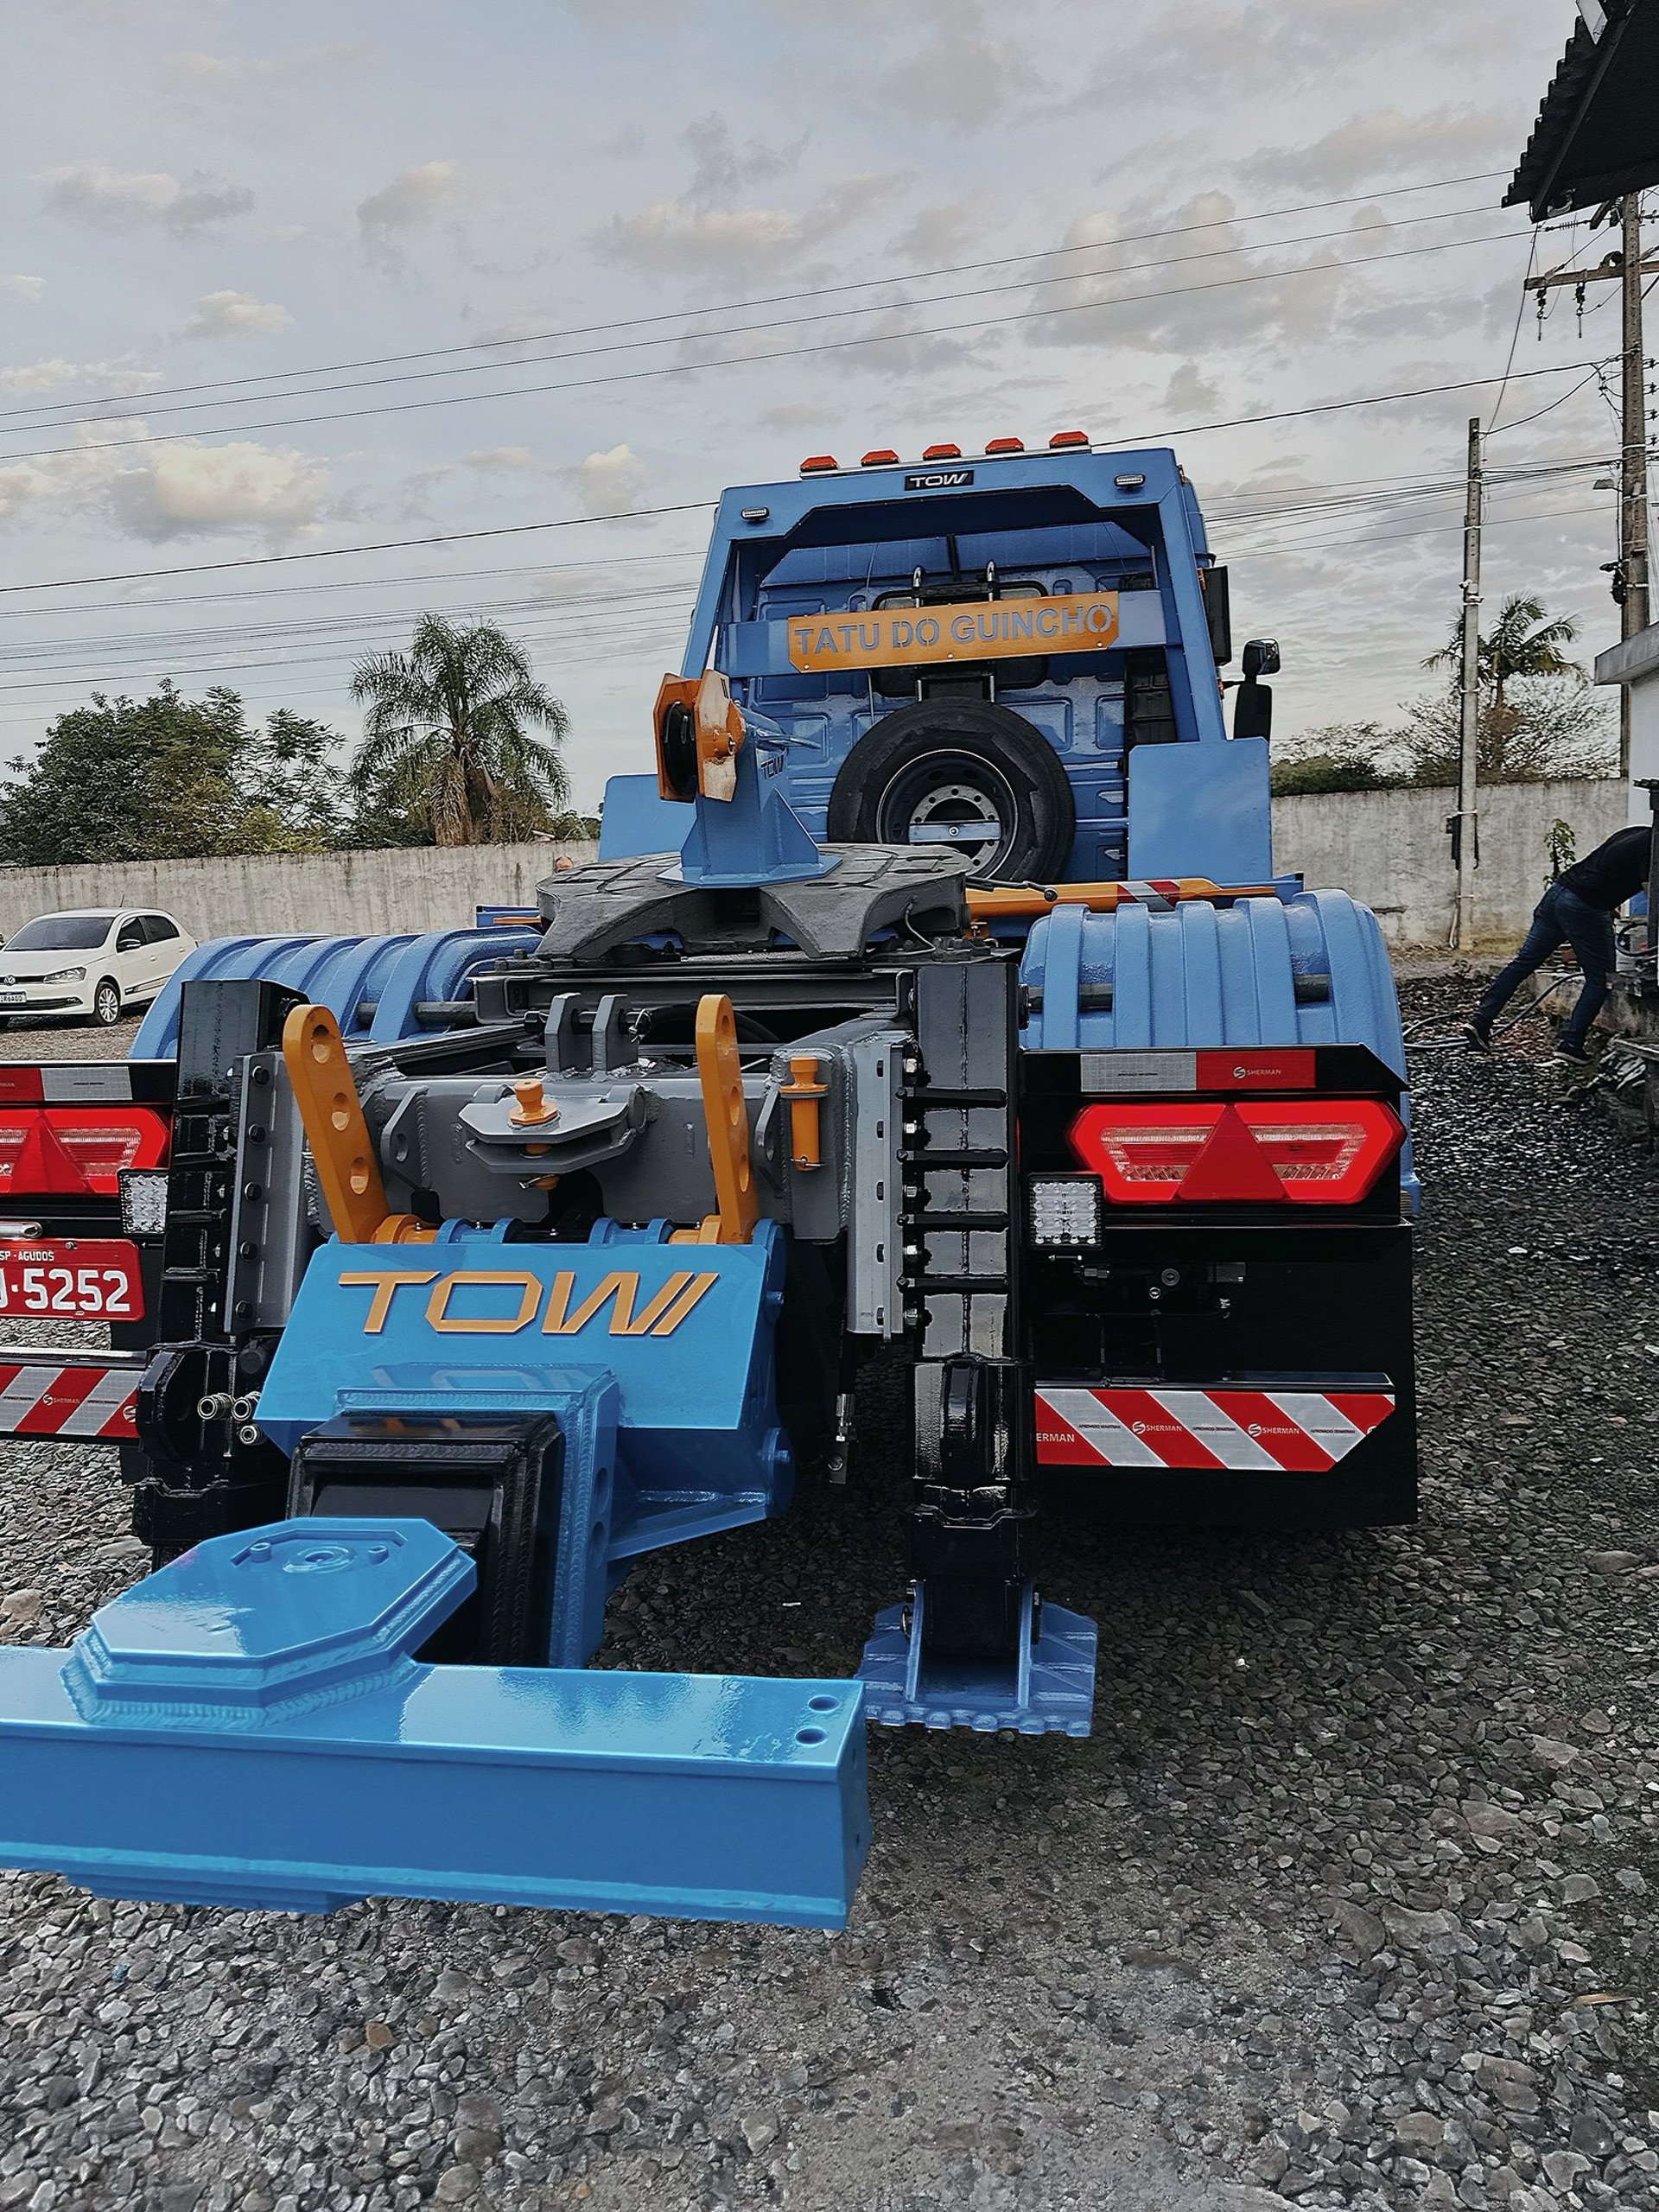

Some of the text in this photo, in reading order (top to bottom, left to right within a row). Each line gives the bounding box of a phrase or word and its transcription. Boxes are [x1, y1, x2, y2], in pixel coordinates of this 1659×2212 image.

[910, 473, 968, 487] TOW
[794, 604, 1112, 655] TATU DO GUINCHO
[760, 754, 784, 780] TOW
[18, 1251, 54, 1262] AGUDOS
[338, 1271, 720, 1337] TOW
[1262, 1426, 1300, 1434] SHERMAN
